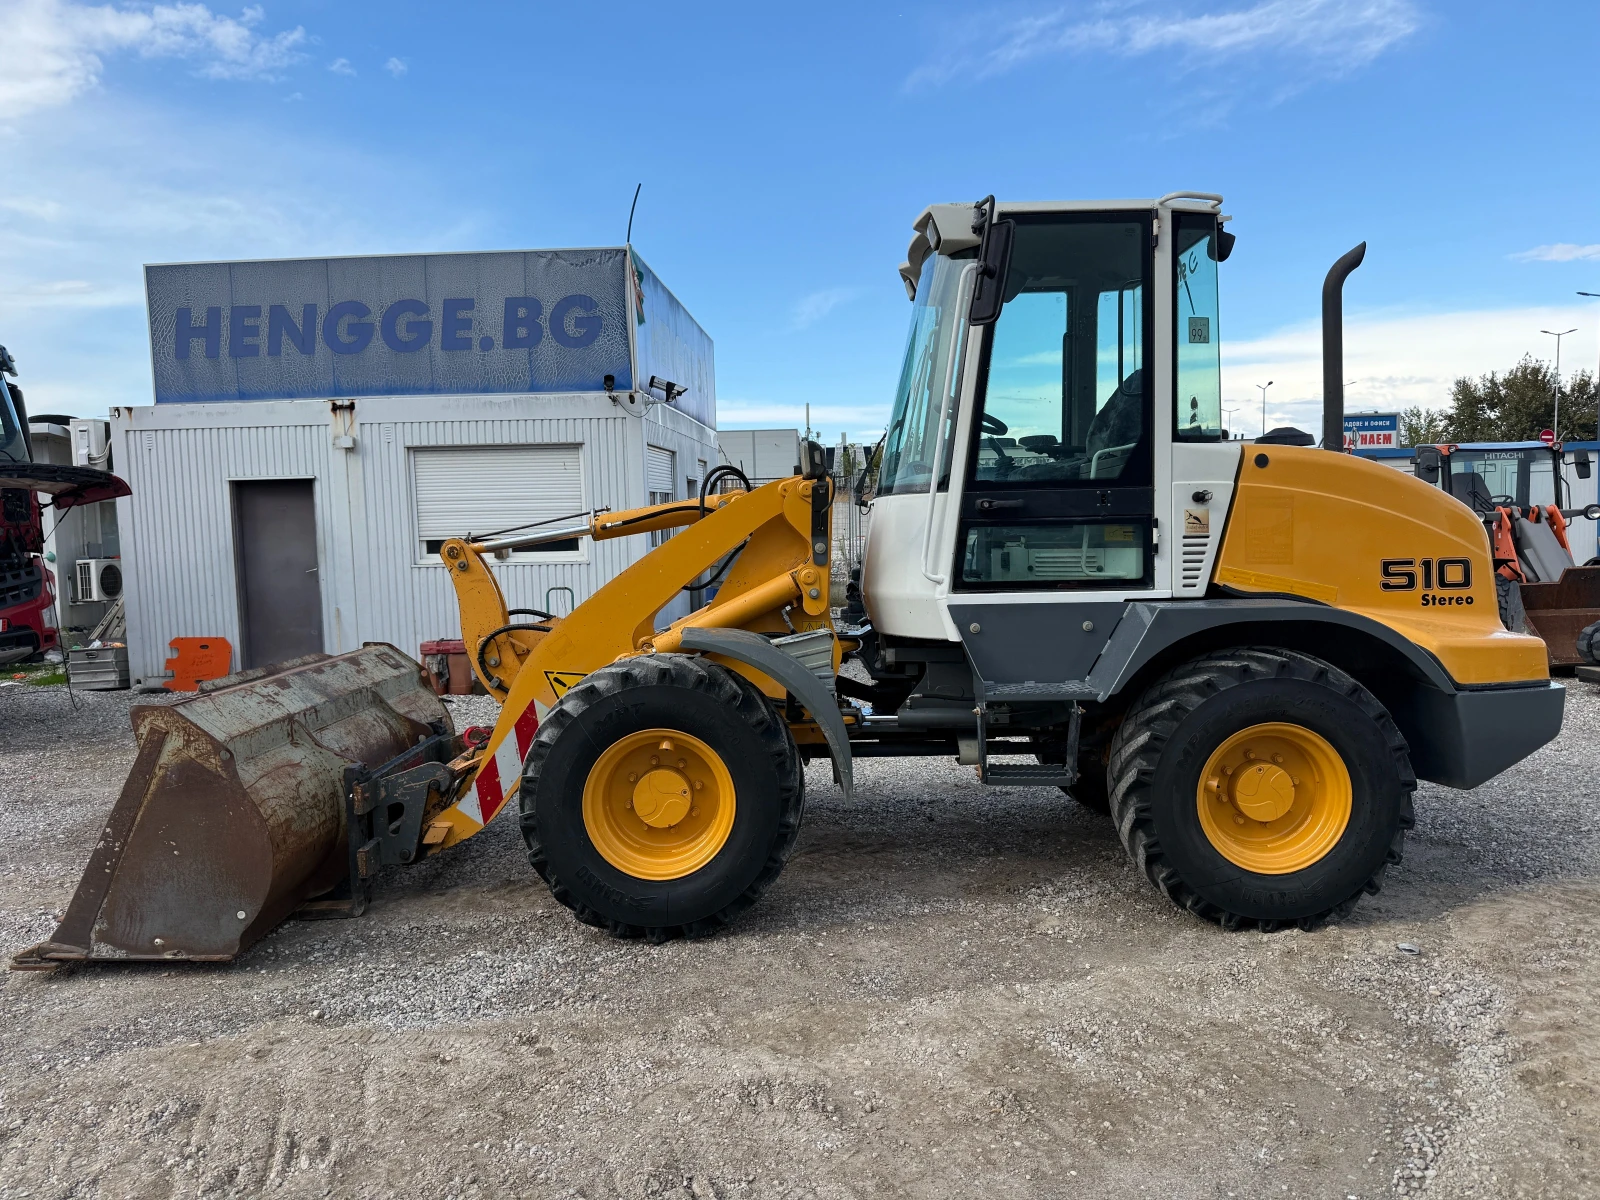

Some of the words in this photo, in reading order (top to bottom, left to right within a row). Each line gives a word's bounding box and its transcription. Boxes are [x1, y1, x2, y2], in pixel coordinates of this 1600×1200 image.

[174, 293, 601, 360] HENGGE.BG
[1360, 433, 1392, 445] НАЕМ
[1484, 452, 1525, 460] HITACHI
[1380, 557, 1473, 591] 510
[1421, 593, 1474, 606] Stereo
